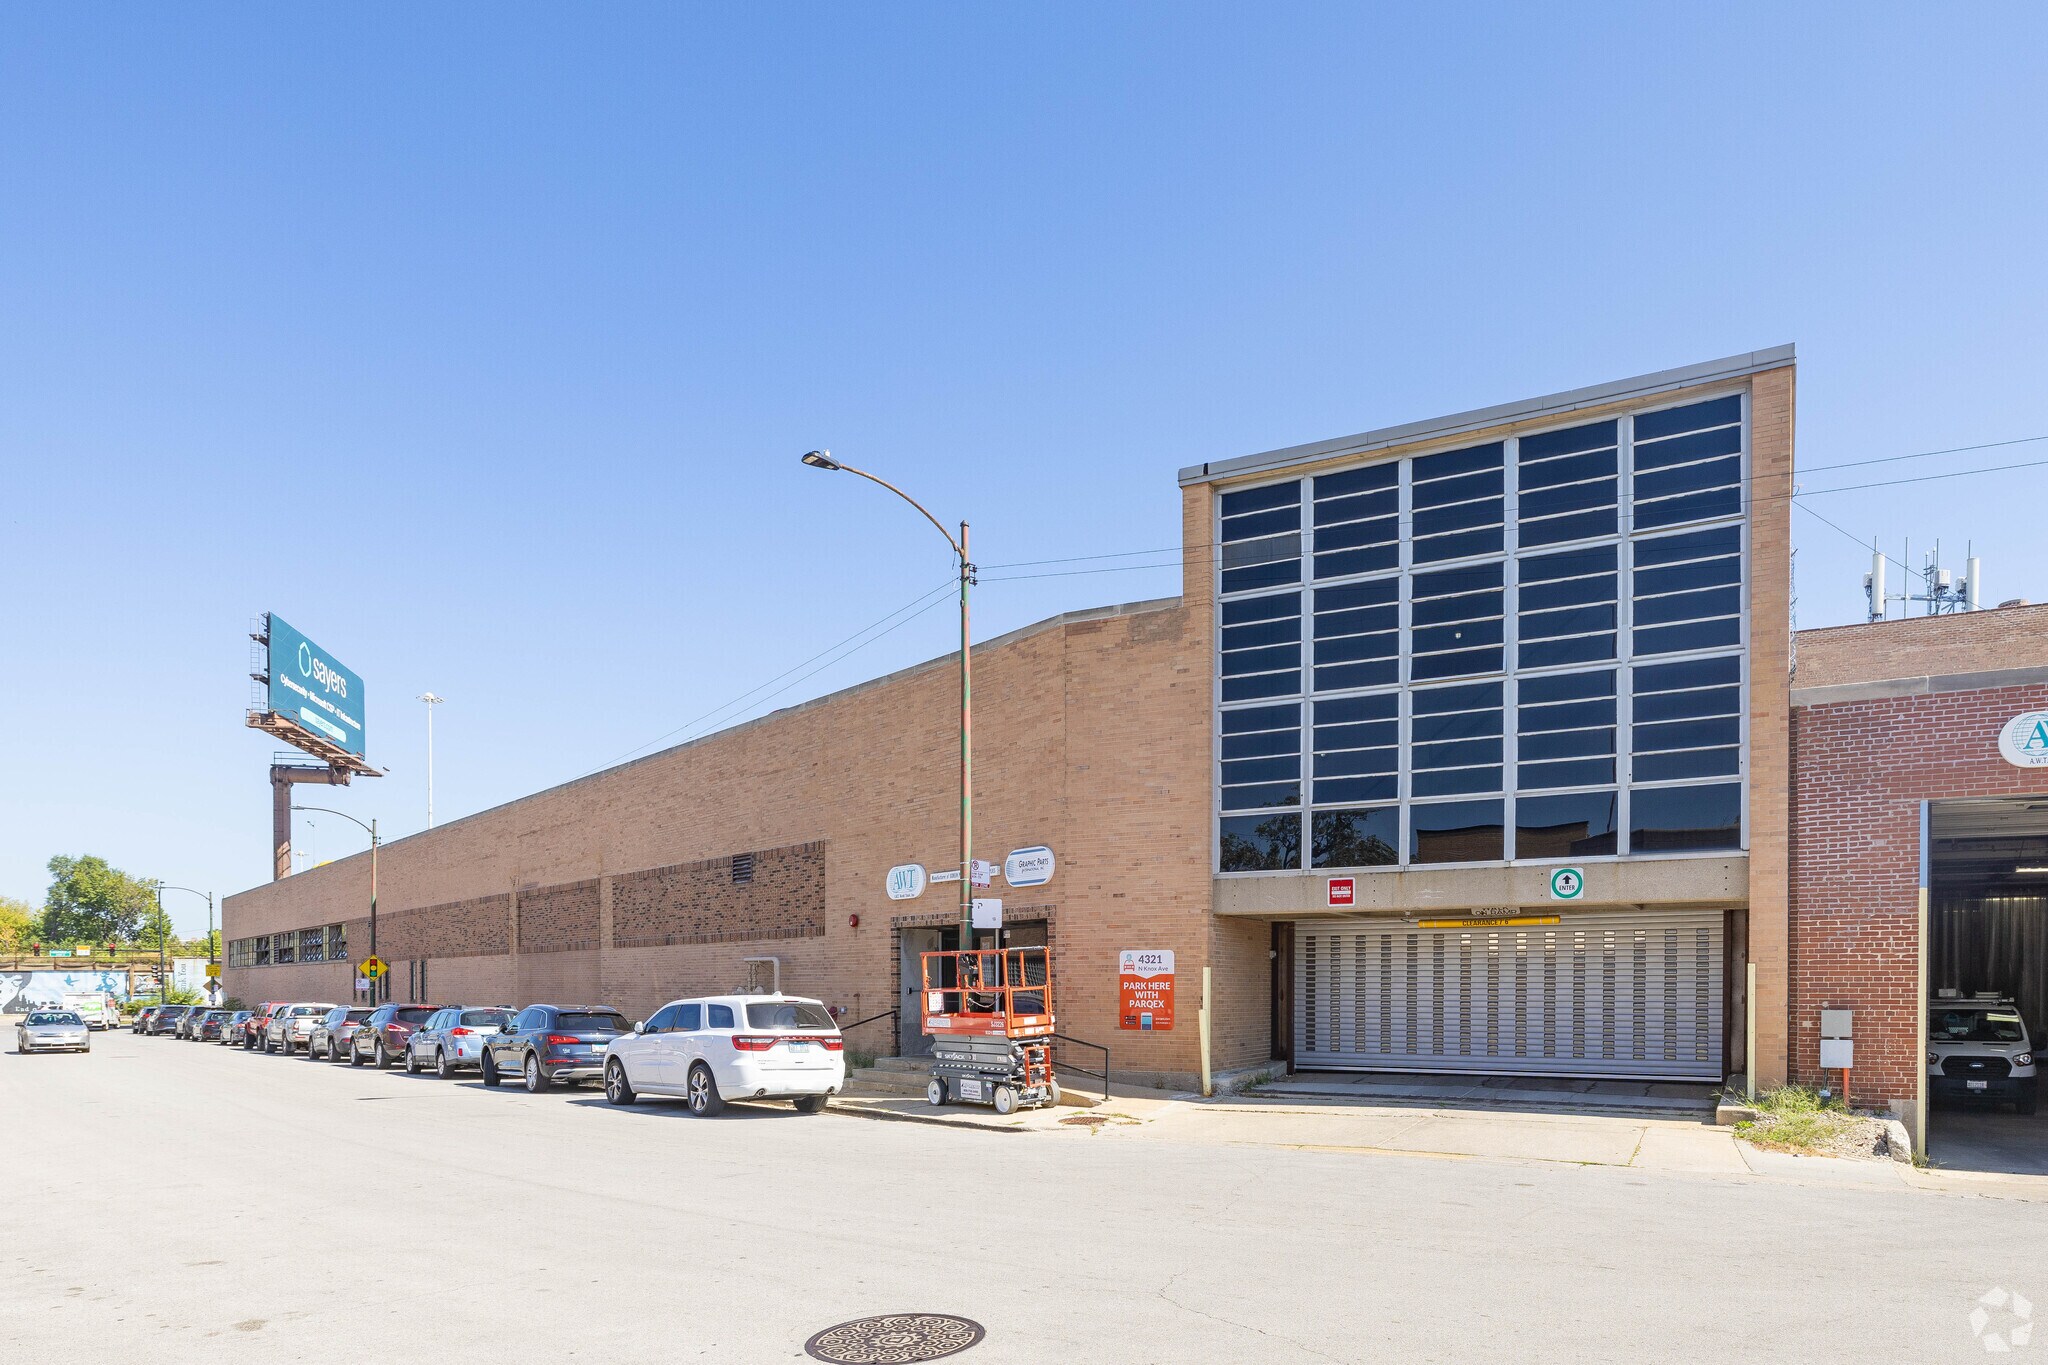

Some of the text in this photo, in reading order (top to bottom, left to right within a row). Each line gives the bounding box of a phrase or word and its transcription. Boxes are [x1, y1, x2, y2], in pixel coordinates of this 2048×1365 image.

[313, 658, 347, 698] sayers
[893, 869, 915, 890] AWT
[1462, 919, 1498, 927] CLEARANCE
[1138, 954, 1162, 964] 4321
[1123, 982, 1170, 990] PARK HERE
[1135, 991, 1158, 999] WITH
[1129, 1000, 1164, 1009] PARQEX
[944, 1052, 966, 1061] SKYJACK
